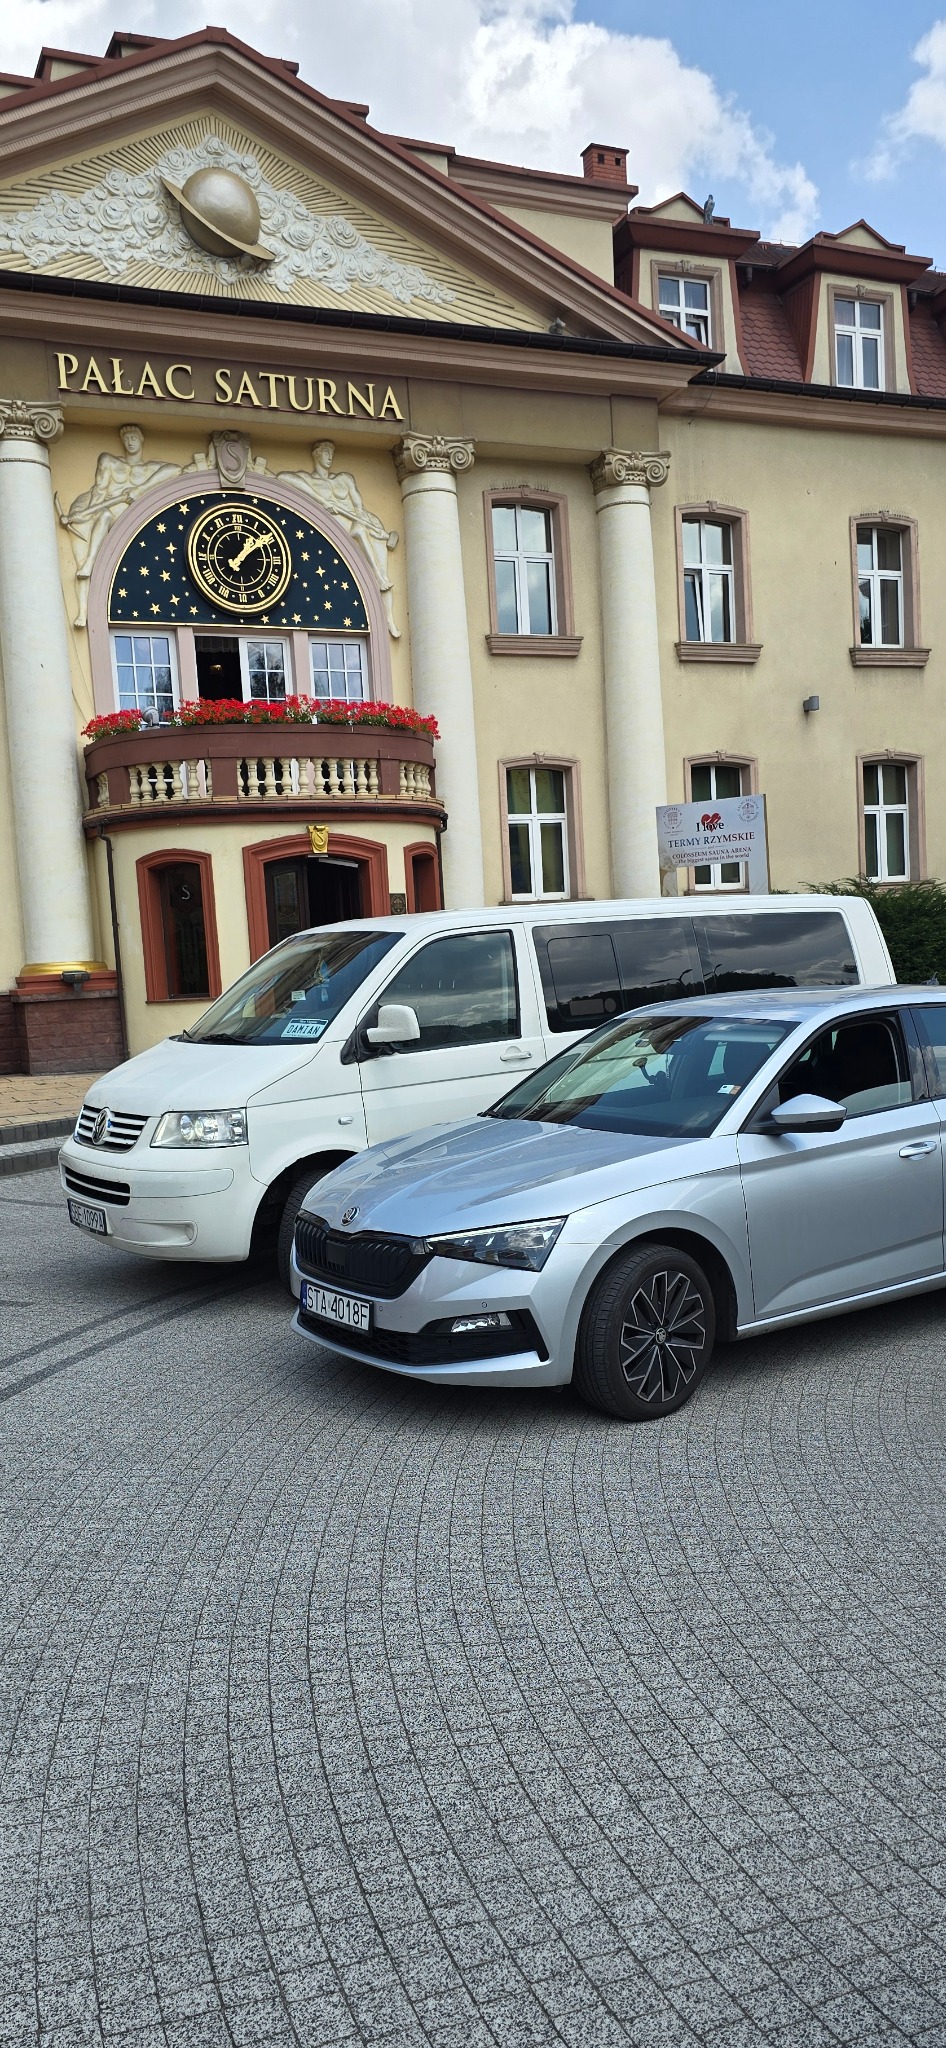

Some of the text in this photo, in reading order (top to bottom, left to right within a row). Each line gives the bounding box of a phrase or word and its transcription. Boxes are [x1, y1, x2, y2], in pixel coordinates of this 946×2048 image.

[54, 352, 405, 420] PAŁAC SATURNA
[696, 821, 725, 832] I love
[668, 831, 755, 848] TERMY RZYMSKIE
[672, 851, 708, 860] COLOSSEUM
[730, 846, 752, 854] ARENA
[181, 884, 190, 900] S
[287, 1024, 321, 1035] DAMIAN
[308, 1287, 368, 1327] STA 4018F
